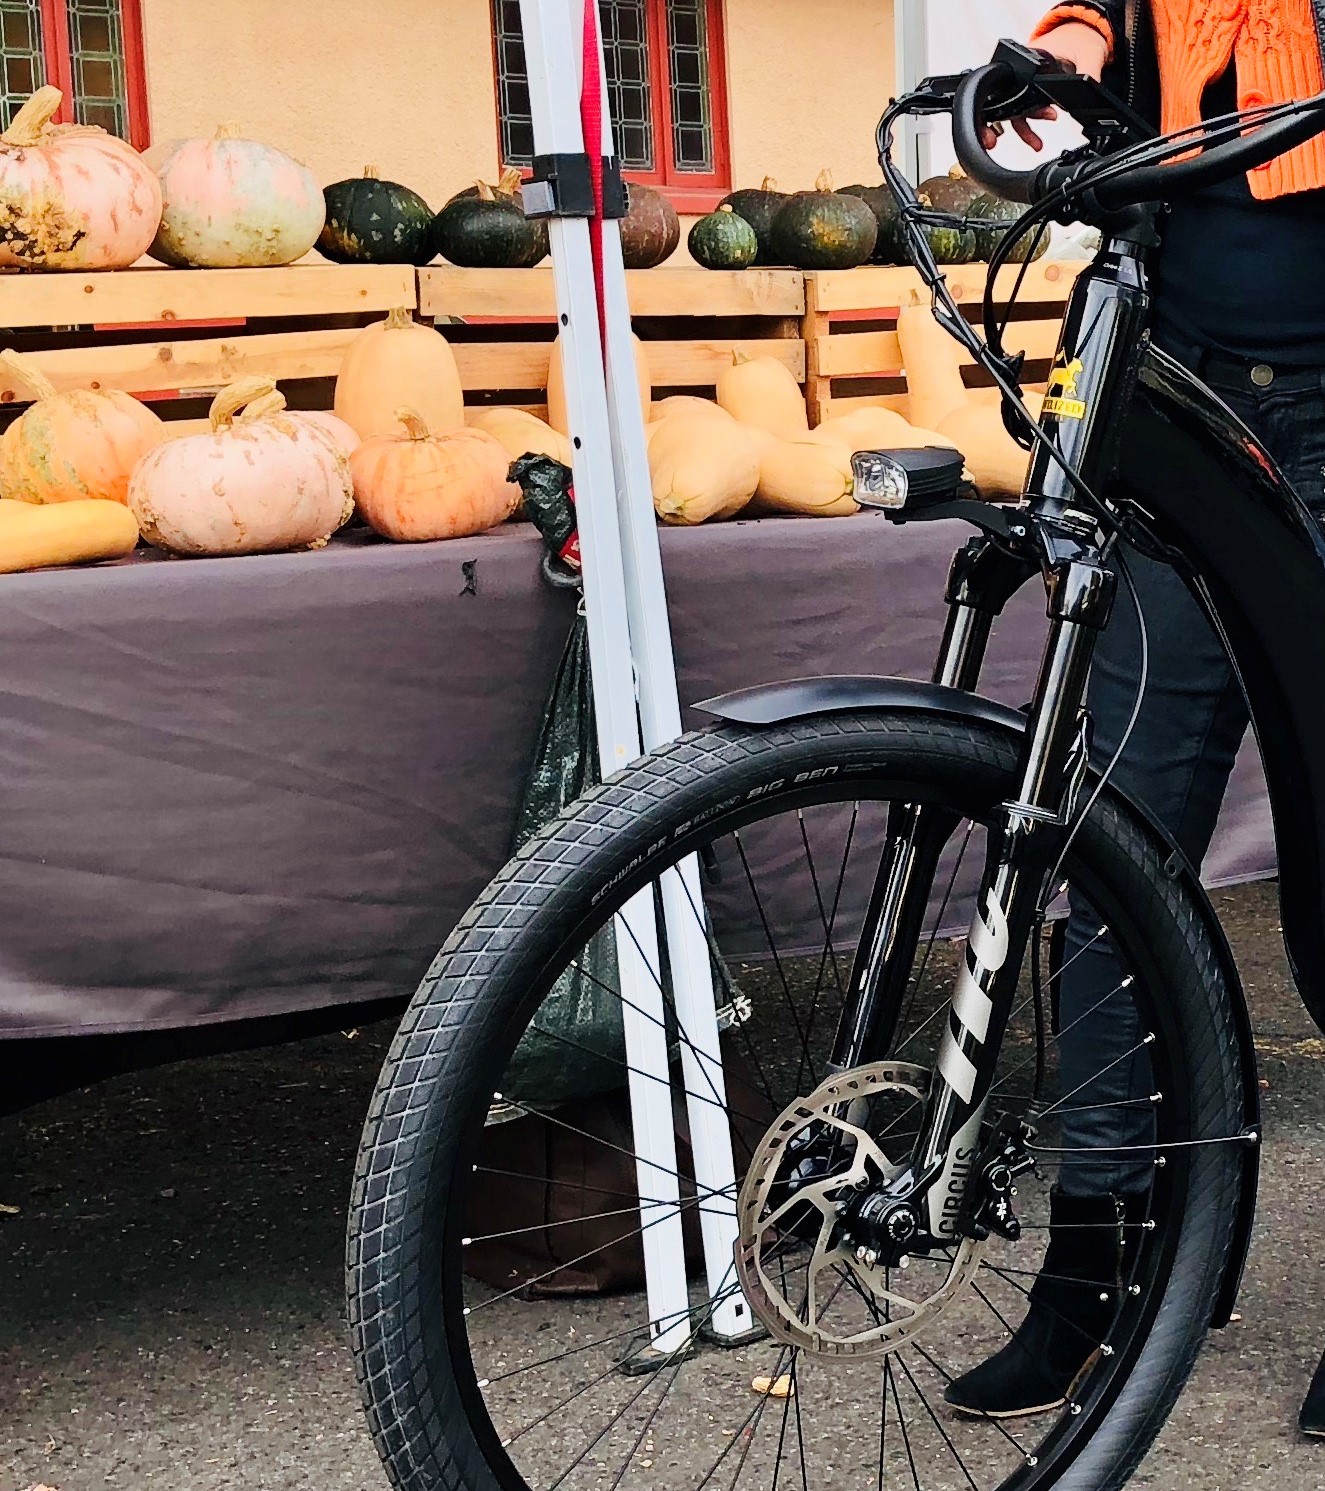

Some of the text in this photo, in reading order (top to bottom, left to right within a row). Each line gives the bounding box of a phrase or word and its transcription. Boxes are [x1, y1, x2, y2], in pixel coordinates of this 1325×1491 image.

[747, 778, 785, 800] BIG
[794, 766, 839, 783] BEN
[591, 836, 667, 906] SCHWALBE
[939, 1147, 973, 1233] CIRCUS
